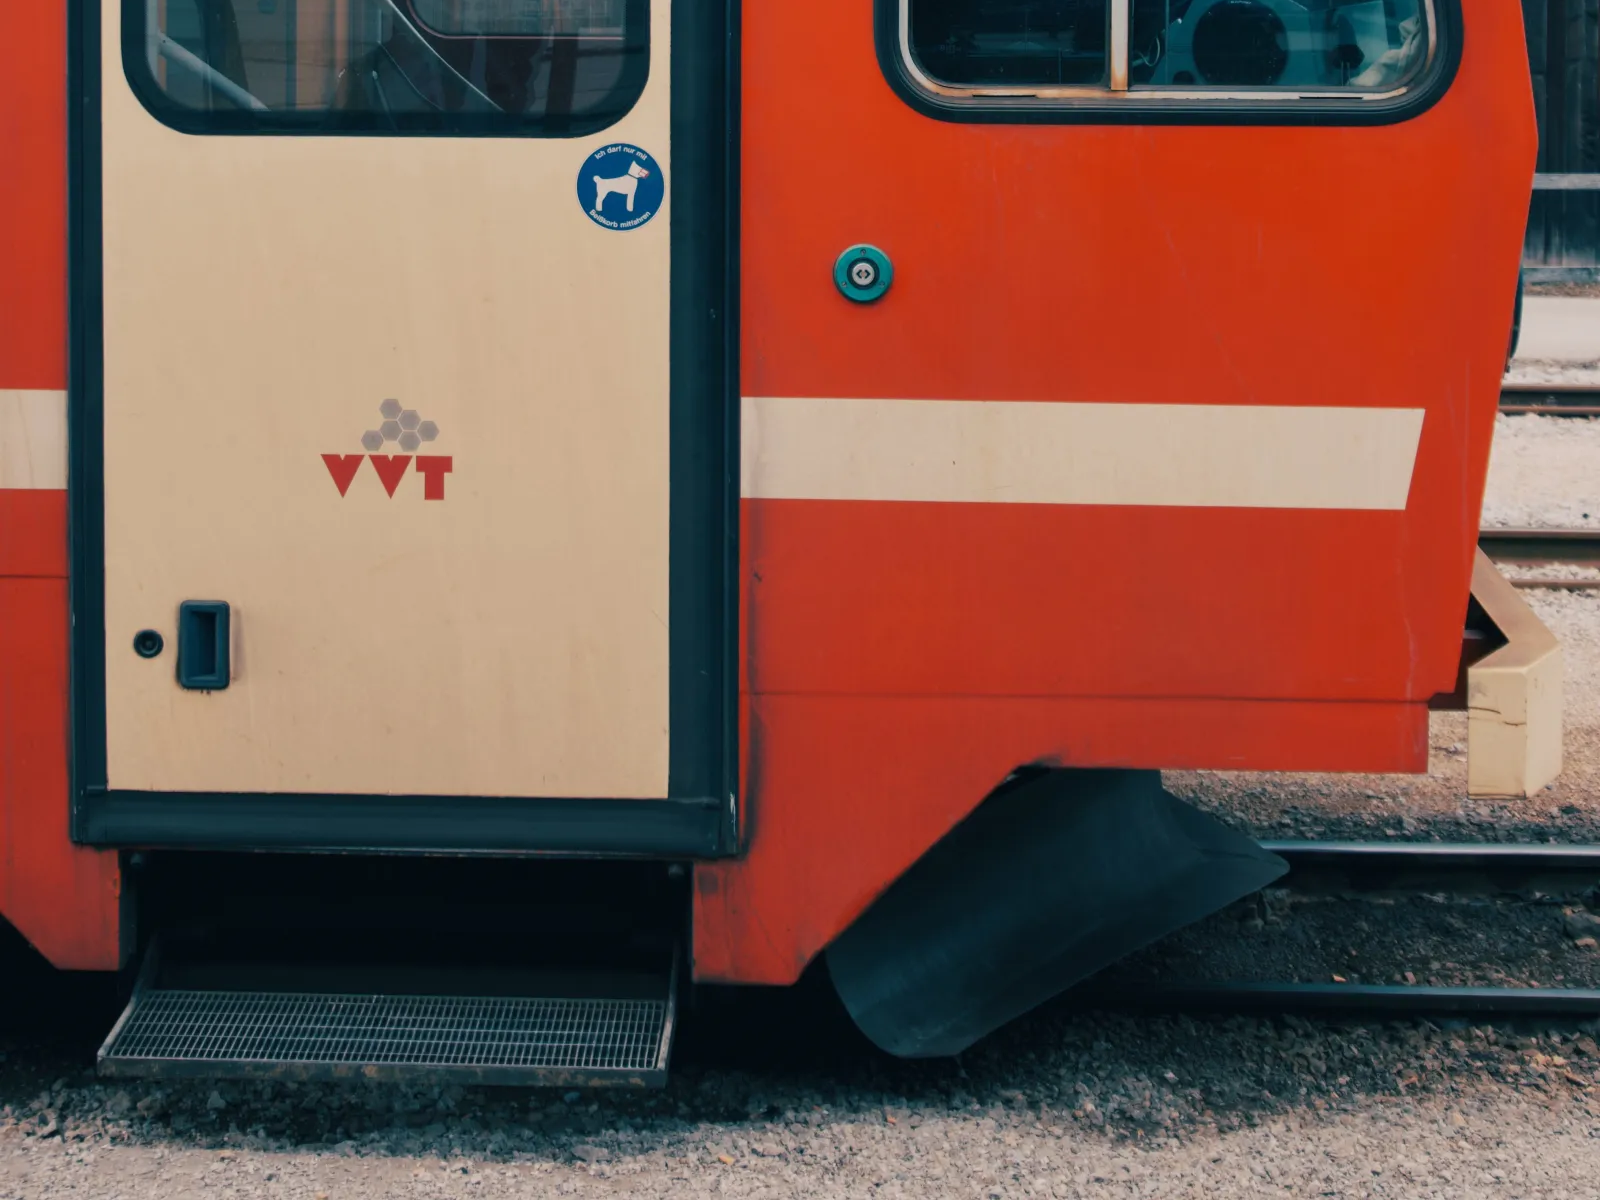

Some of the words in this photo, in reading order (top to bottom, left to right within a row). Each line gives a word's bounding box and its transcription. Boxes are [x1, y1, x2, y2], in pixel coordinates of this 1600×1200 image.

[594, 150, 606, 160] Ich
[607, 145, 621, 154] darf
[623, 146, 635, 154] nur
[636, 151, 648, 161] mit
[589, 208, 618, 228] Beißkorb
[620, 211, 651, 228] mitfahren
[320, 454, 453, 500] VVT
